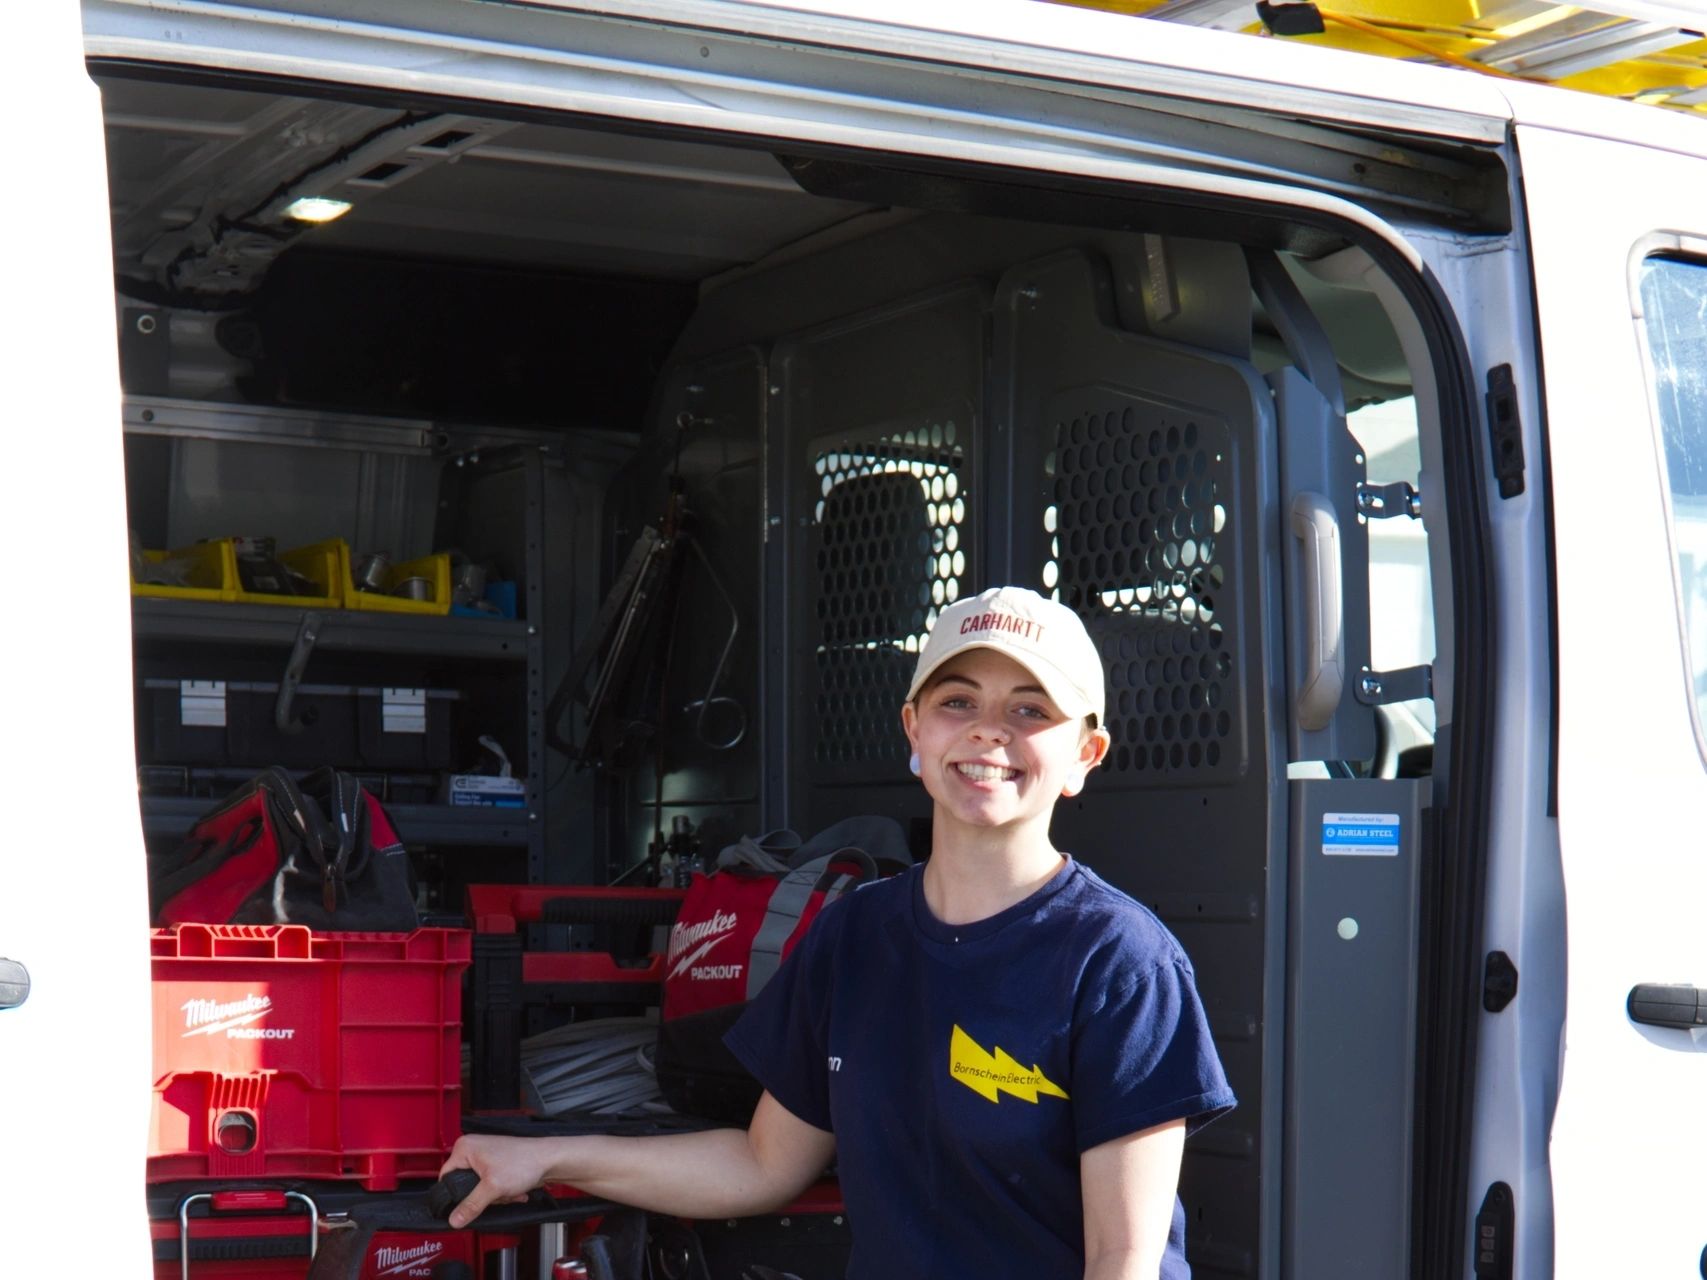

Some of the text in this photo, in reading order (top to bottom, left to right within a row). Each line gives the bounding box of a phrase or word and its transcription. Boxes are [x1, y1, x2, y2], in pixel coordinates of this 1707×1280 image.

[960, 613, 1045, 642] CARHARTT
[1337, 828, 1394, 838] ADRIAN STEEL
[691, 965, 743, 980] PACKOUT
[180, 994, 271, 1027] Milwaukee
[226, 1028, 295, 1040] PACKOUT
[374, 1240, 443, 1270] Milwaukee
[409, 1267, 432, 1277] PAC
